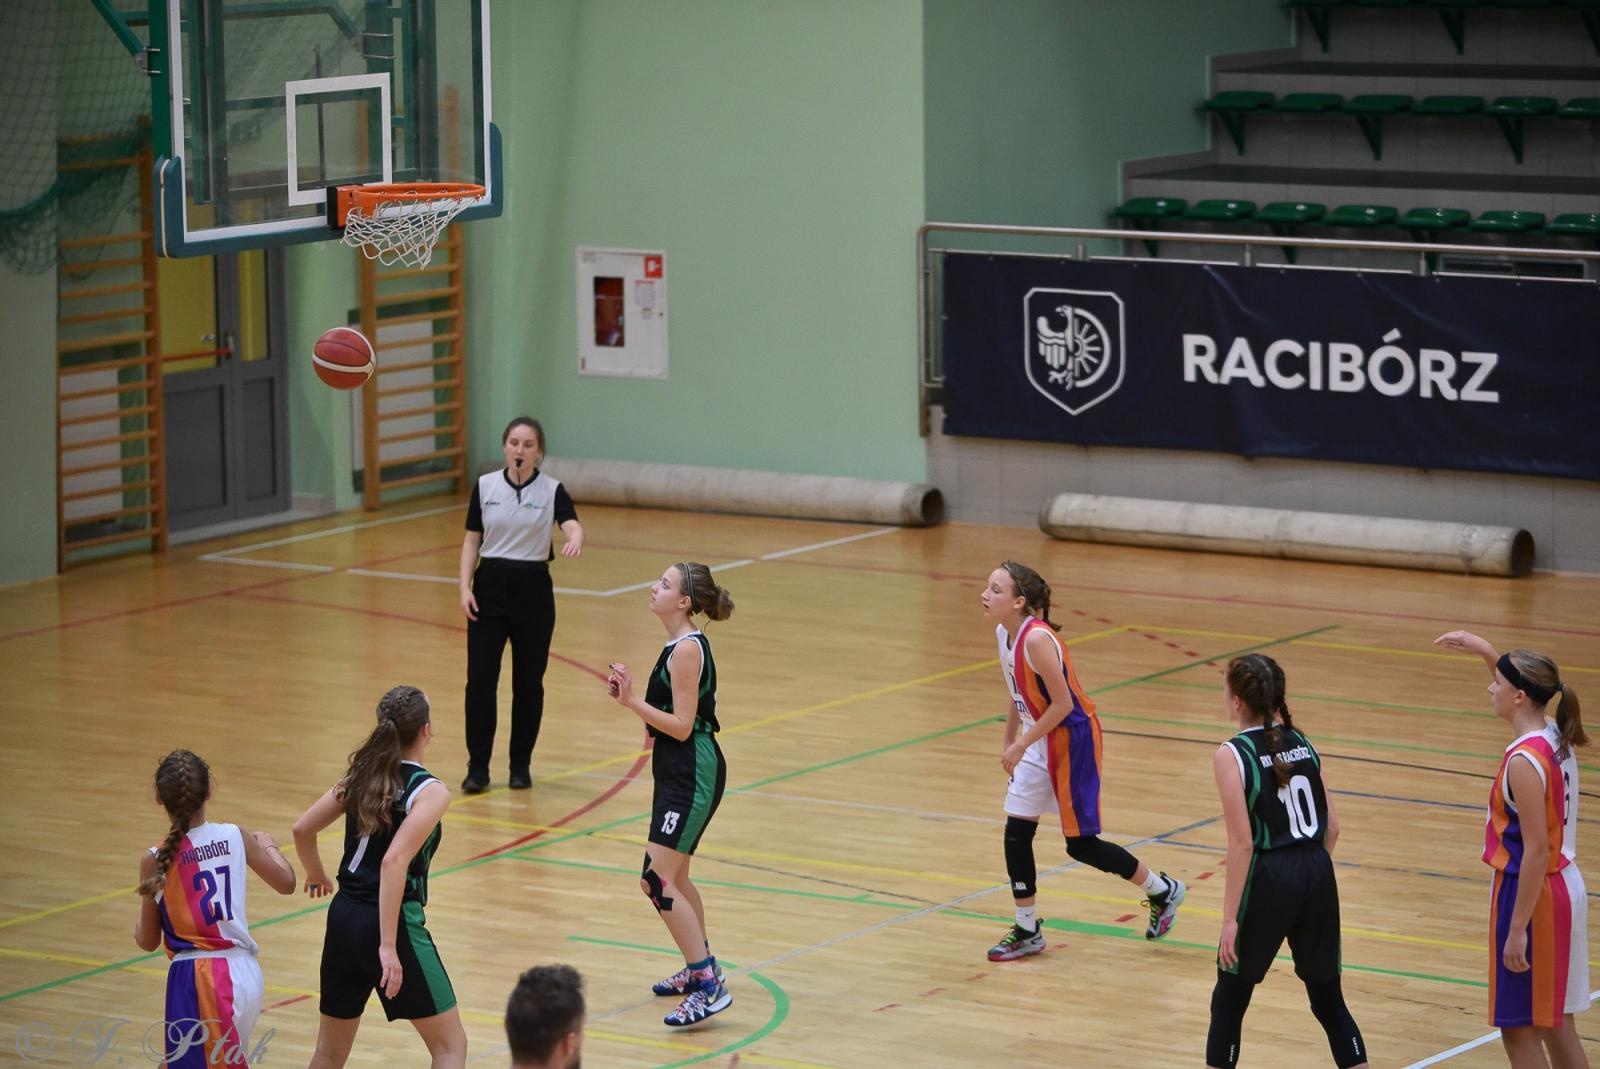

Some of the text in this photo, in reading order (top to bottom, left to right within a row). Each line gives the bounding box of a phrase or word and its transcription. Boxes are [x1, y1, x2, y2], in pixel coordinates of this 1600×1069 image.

[1182, 327, 1500, 403] RACIBÓRZ
[660, 810, 681, 835] 13
[1277, 774, 1319, 839] 10
[181, 839, 231, 865] RACIBÓRZ
[192, 864, 234, 926] 27
